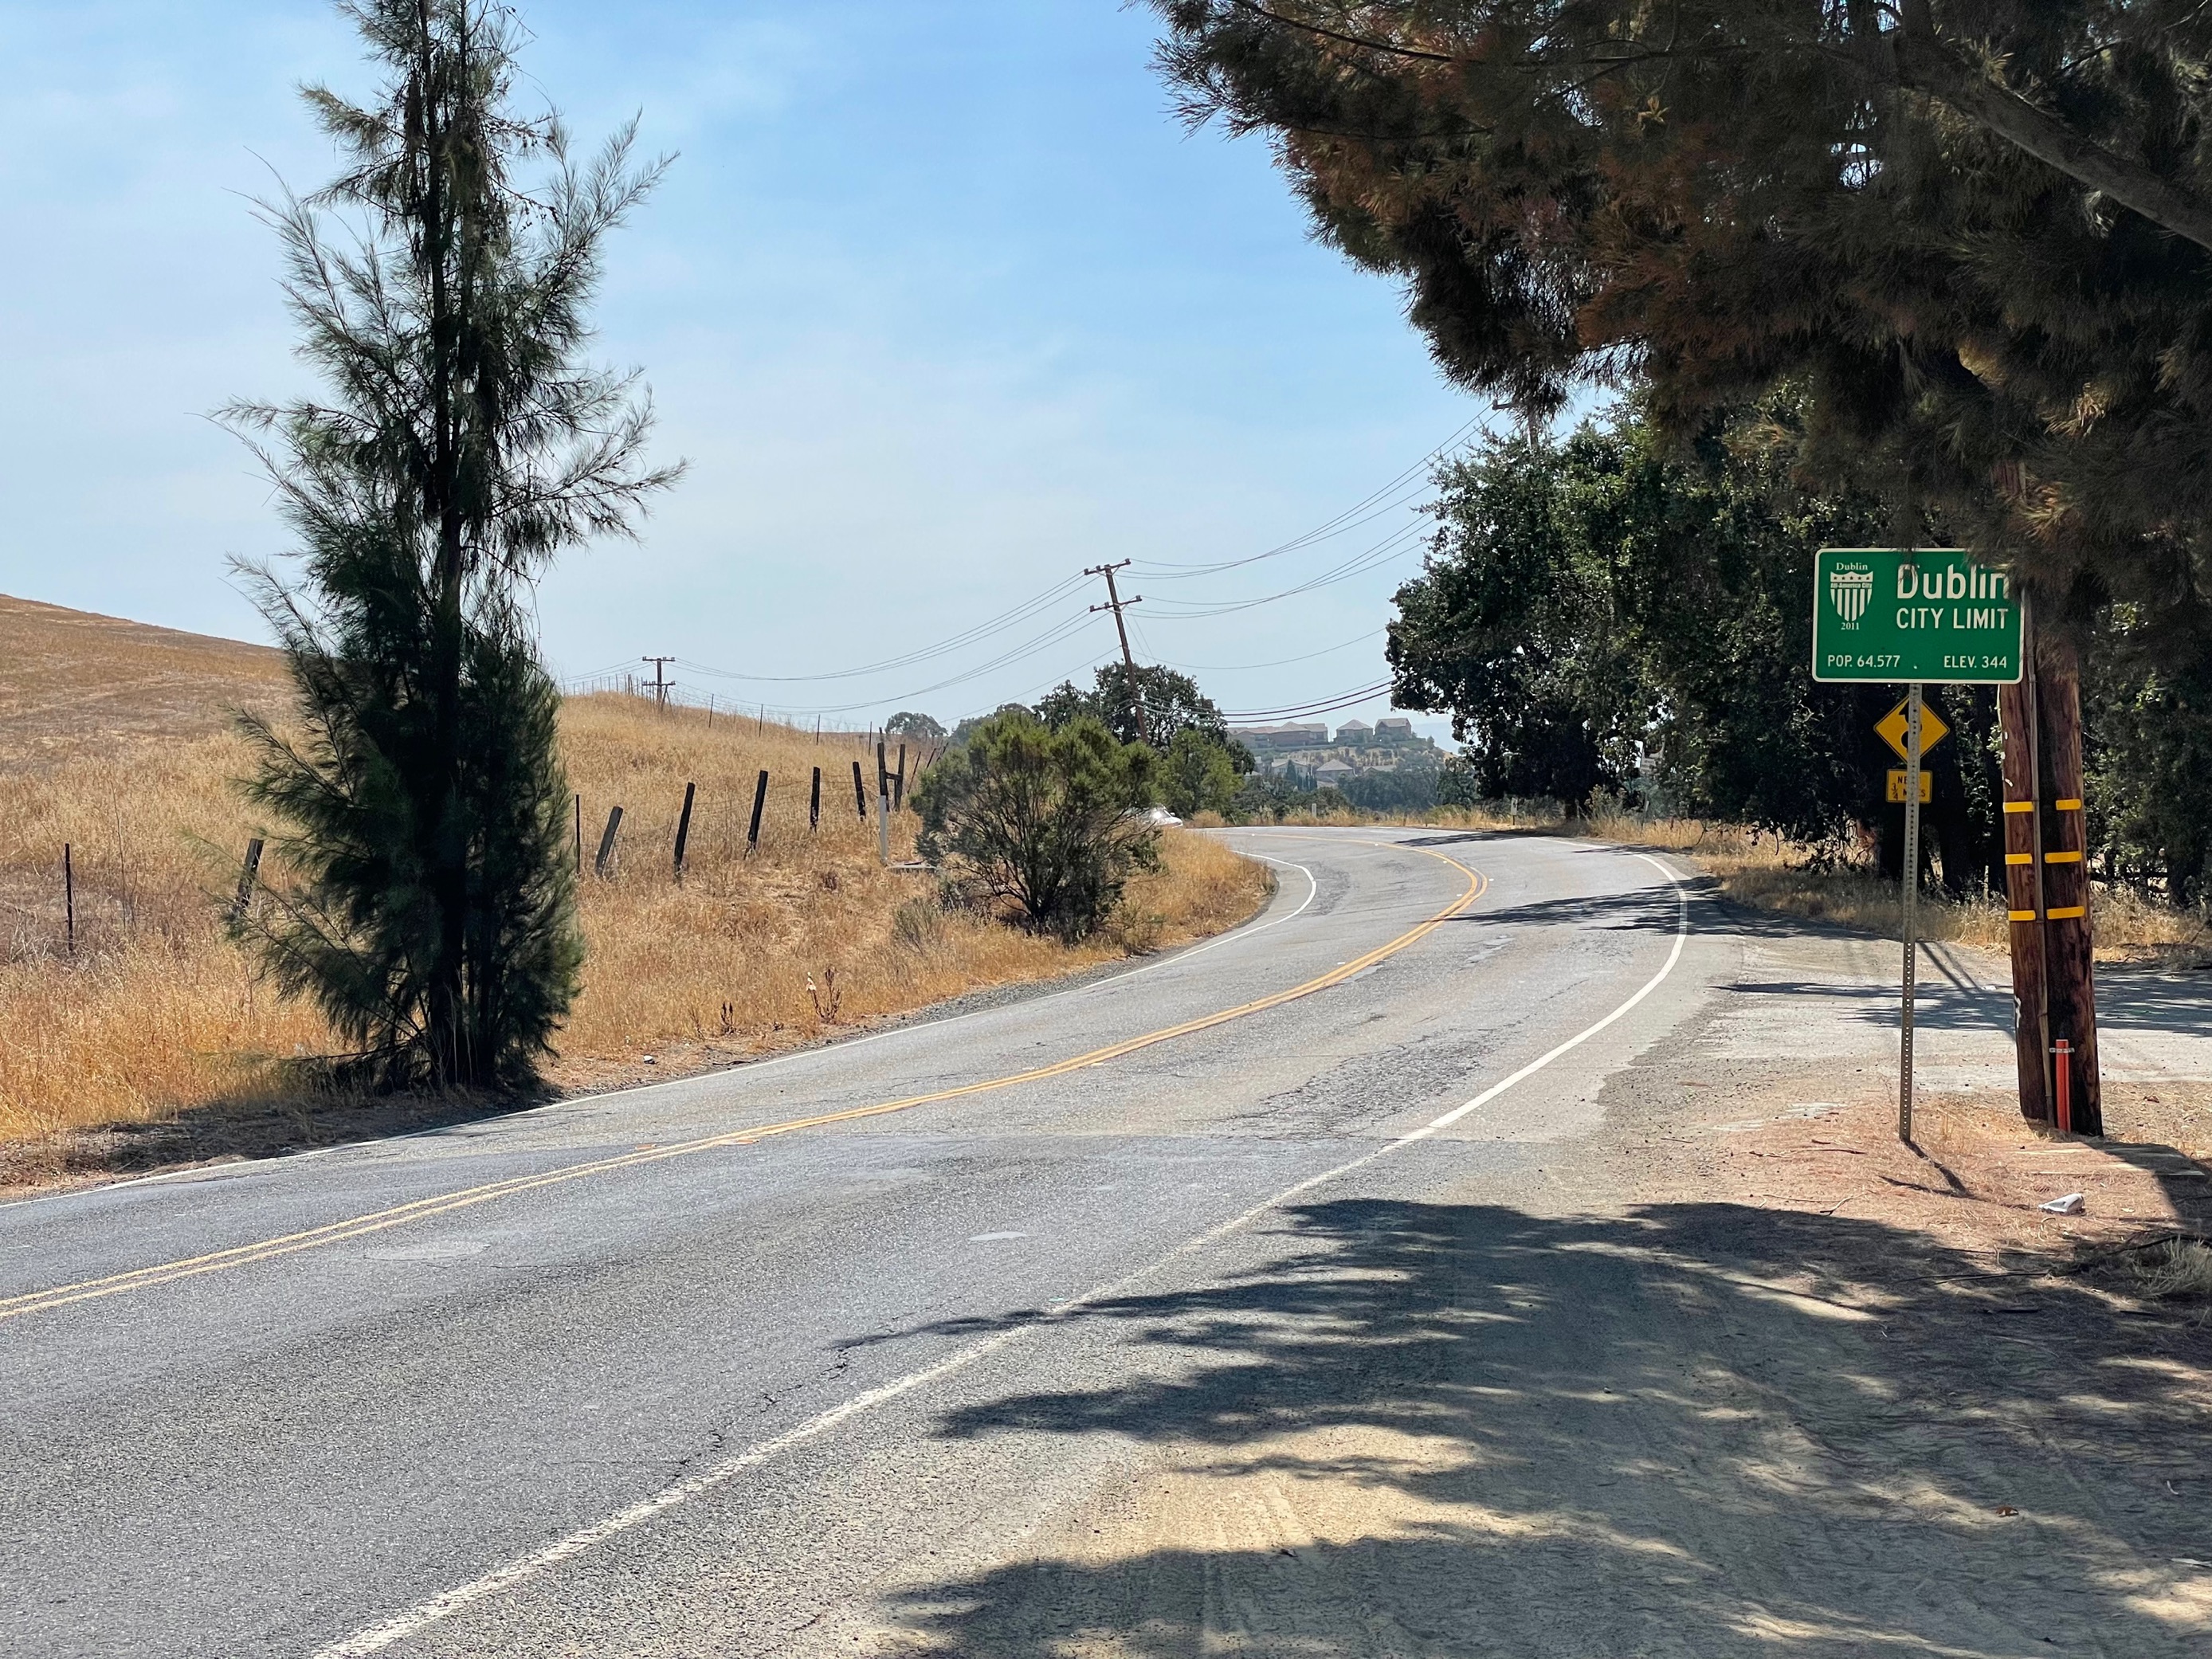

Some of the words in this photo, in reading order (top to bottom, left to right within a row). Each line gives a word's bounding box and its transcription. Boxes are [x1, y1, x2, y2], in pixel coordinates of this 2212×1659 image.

[1896, 563, 2010, 599] Dublin
[1896, 607, 1943, 629] CITY
[1953, 608, 2009, 629] LIMIT
[1827, 654, 1853, 668] POP.
[1943, 655, 1977, 669] ELEV.
[1982, 655, 2007, 669] 344
